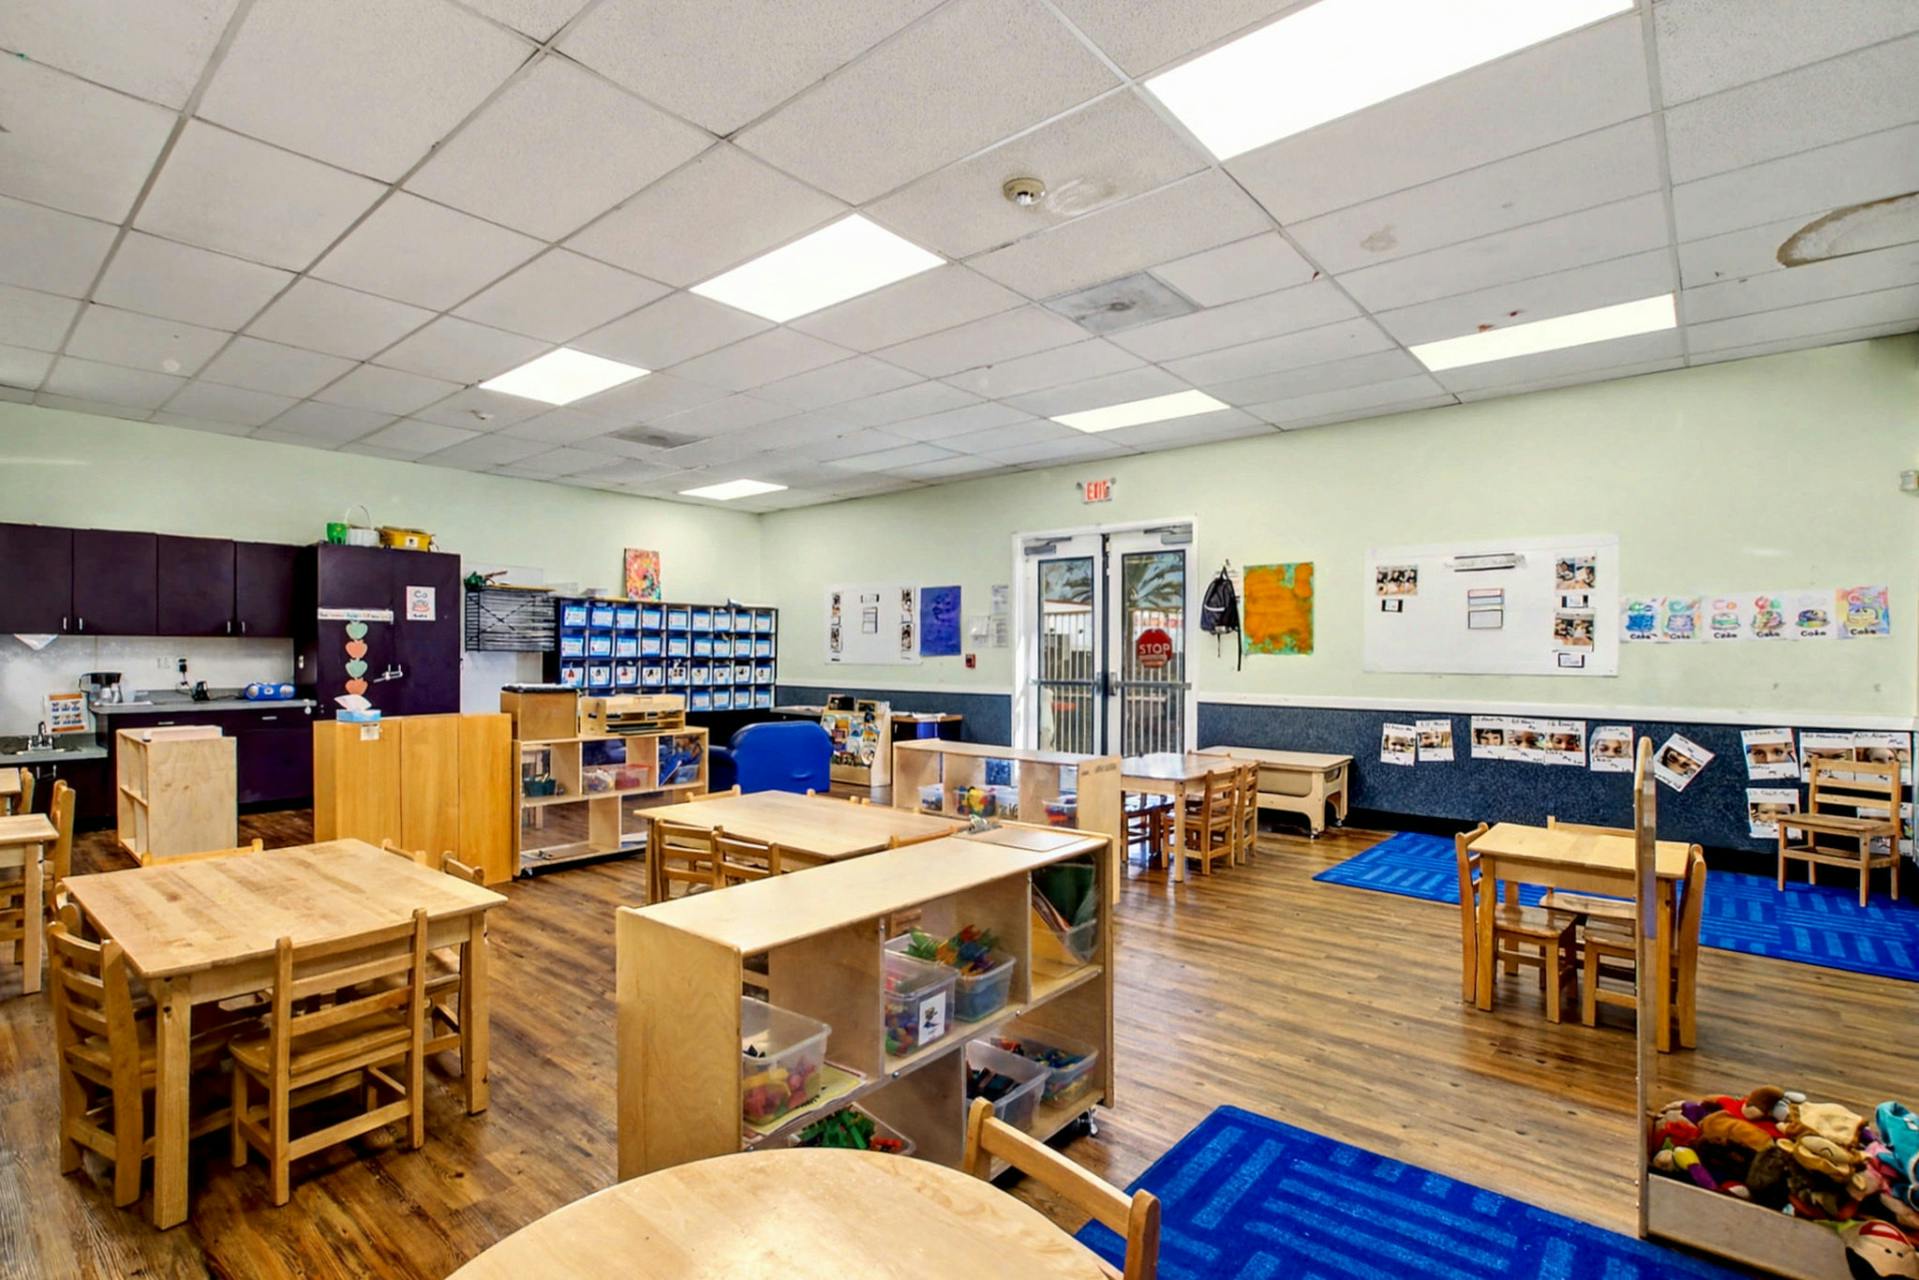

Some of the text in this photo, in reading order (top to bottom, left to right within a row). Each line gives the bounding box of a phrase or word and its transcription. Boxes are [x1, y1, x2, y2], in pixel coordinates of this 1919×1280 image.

[1087, 481, 1109, 502] EXIT
[1713, 632, 1738, 640] Cake
[1800, 629, 1827, 637] Cake
[1139, 643, 1170, 656] STOP
